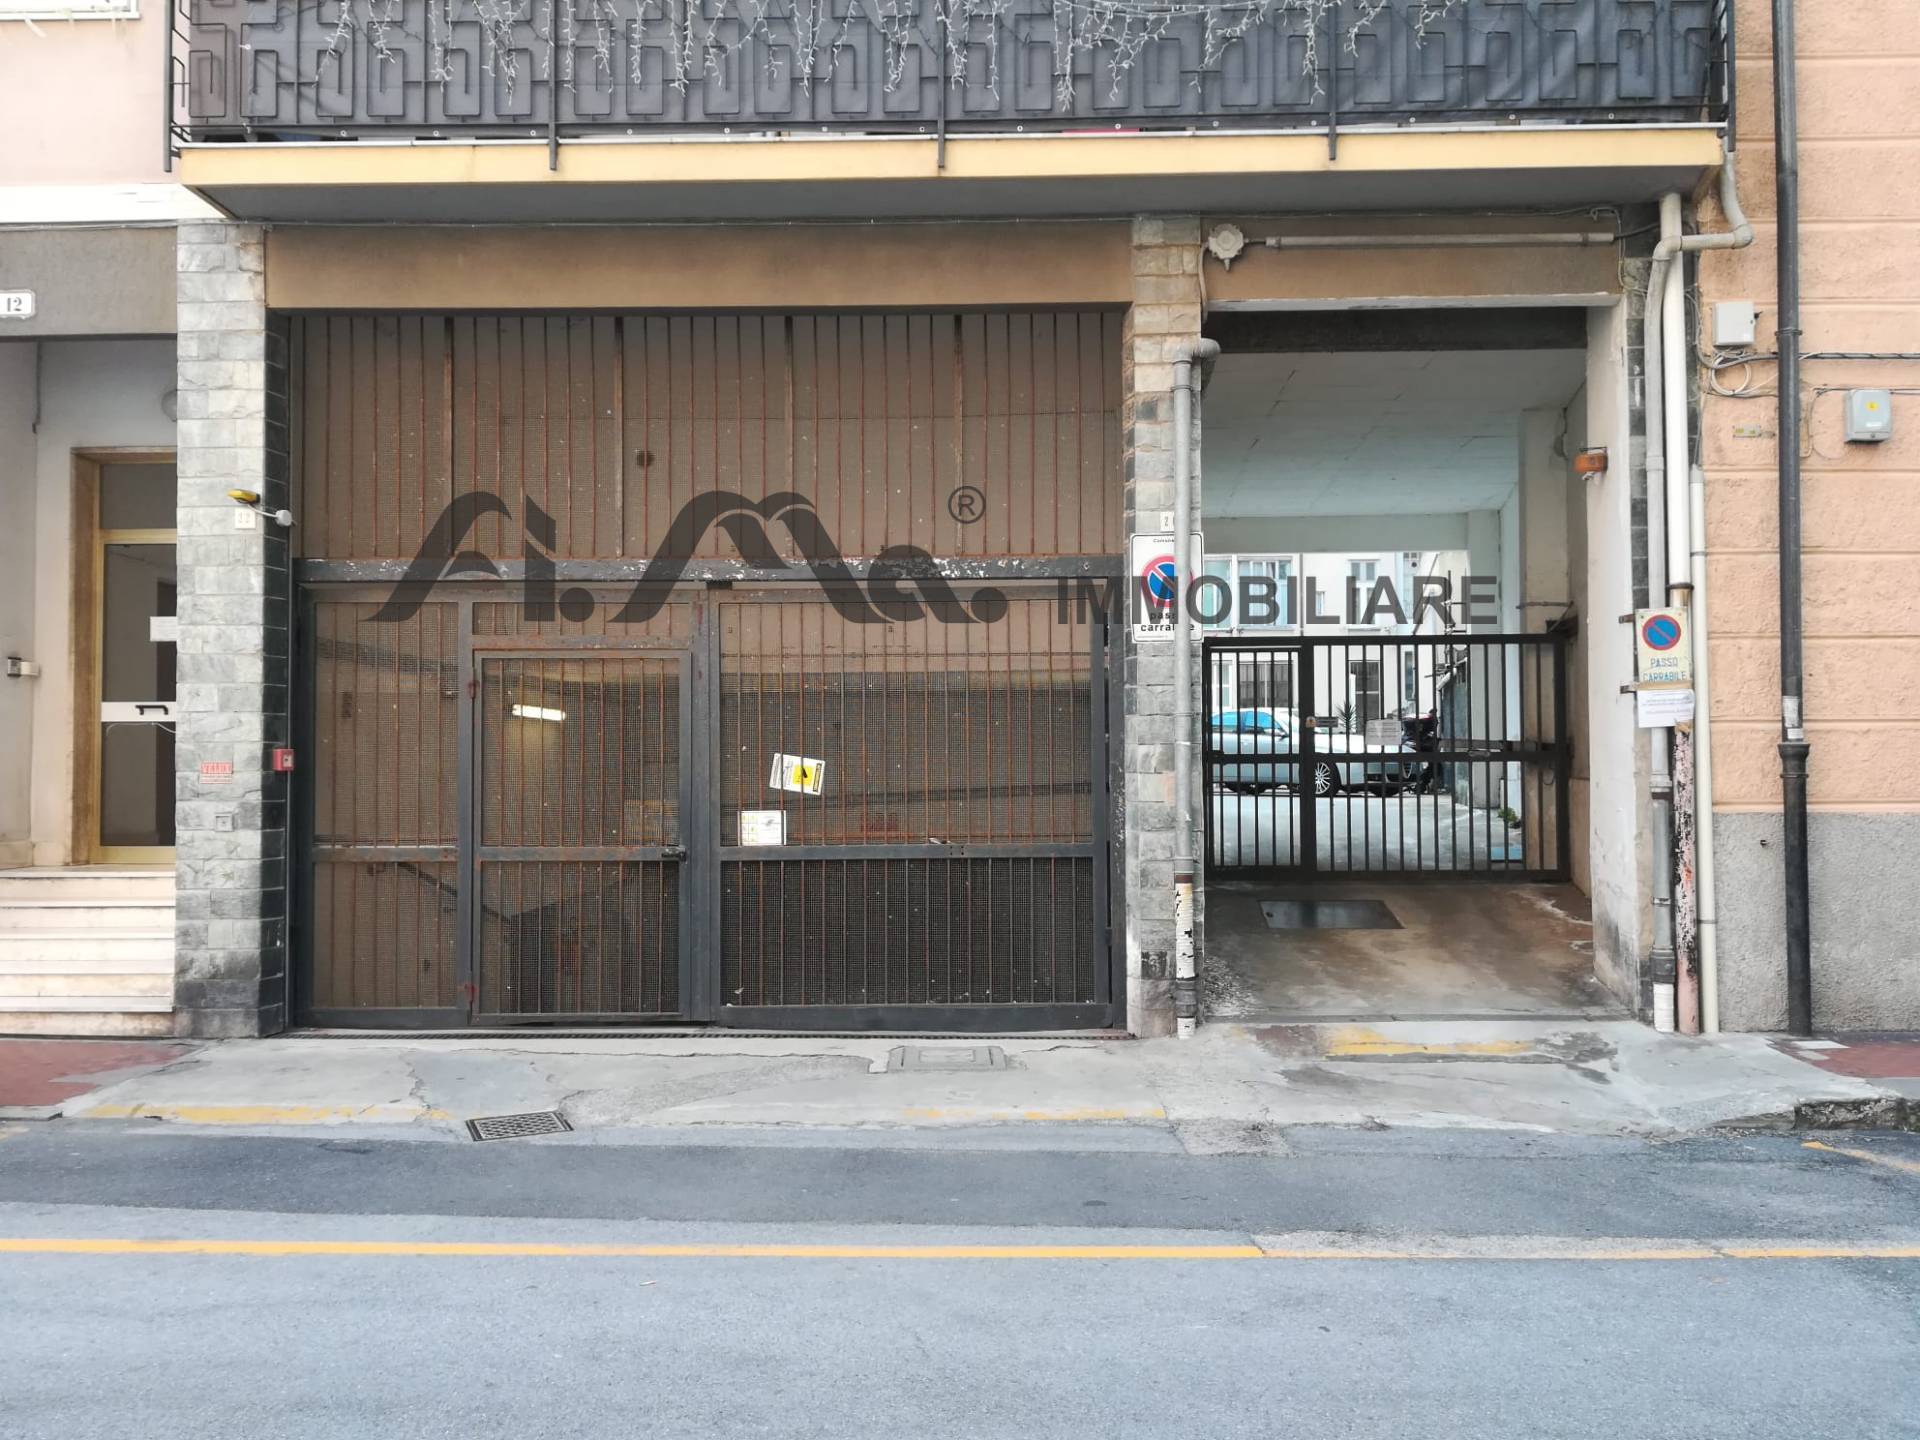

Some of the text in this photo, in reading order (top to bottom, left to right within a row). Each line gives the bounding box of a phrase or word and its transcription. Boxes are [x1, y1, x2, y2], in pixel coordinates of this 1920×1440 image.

[7, 297, 22, 312] 12
[1650, 657, 1678, 668] PASSO
[1643, 671, 1687, 682] CARRABILE
